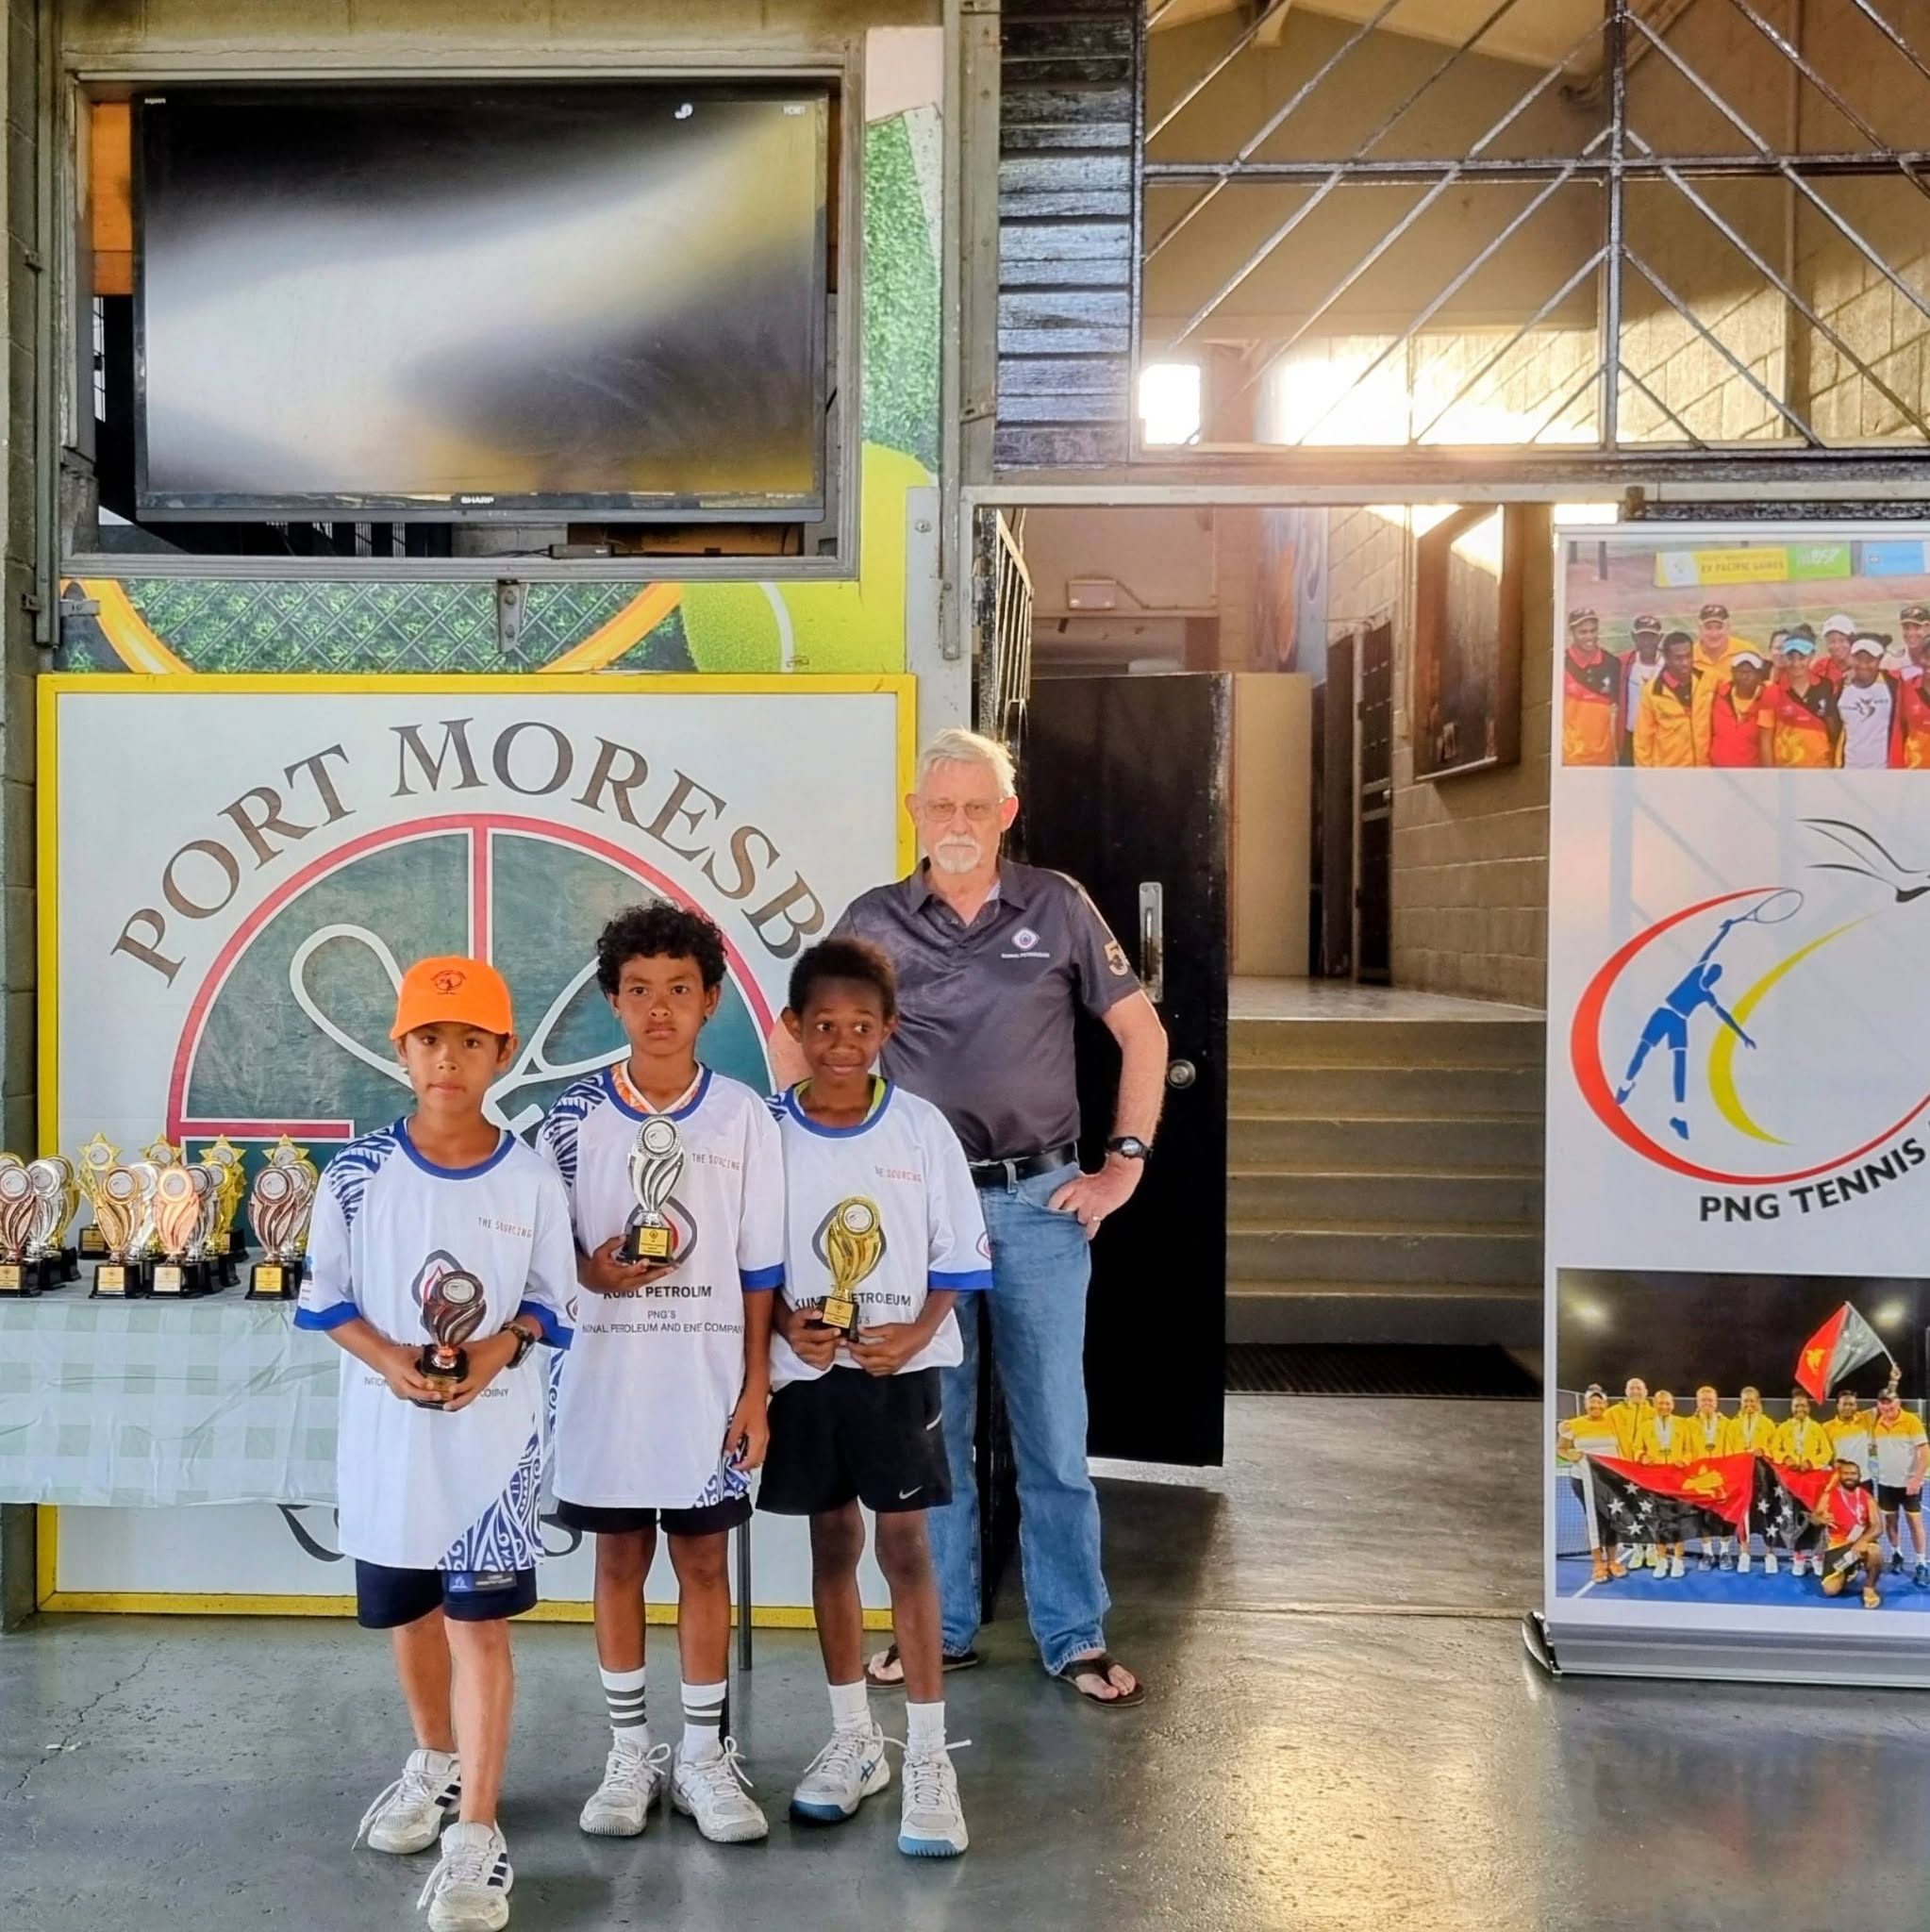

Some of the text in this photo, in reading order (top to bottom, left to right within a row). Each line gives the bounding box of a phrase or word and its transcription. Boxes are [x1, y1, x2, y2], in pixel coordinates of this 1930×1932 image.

[109, 718, 825, 988] PORT MORESB
[1700, 1138, 1926, 1222] PNG TENNIS
[478, 1217, 491, 1228] THE
[647, 1309, 676, 1320] PNG'S
[660, 1323, 681, 1333] AND
